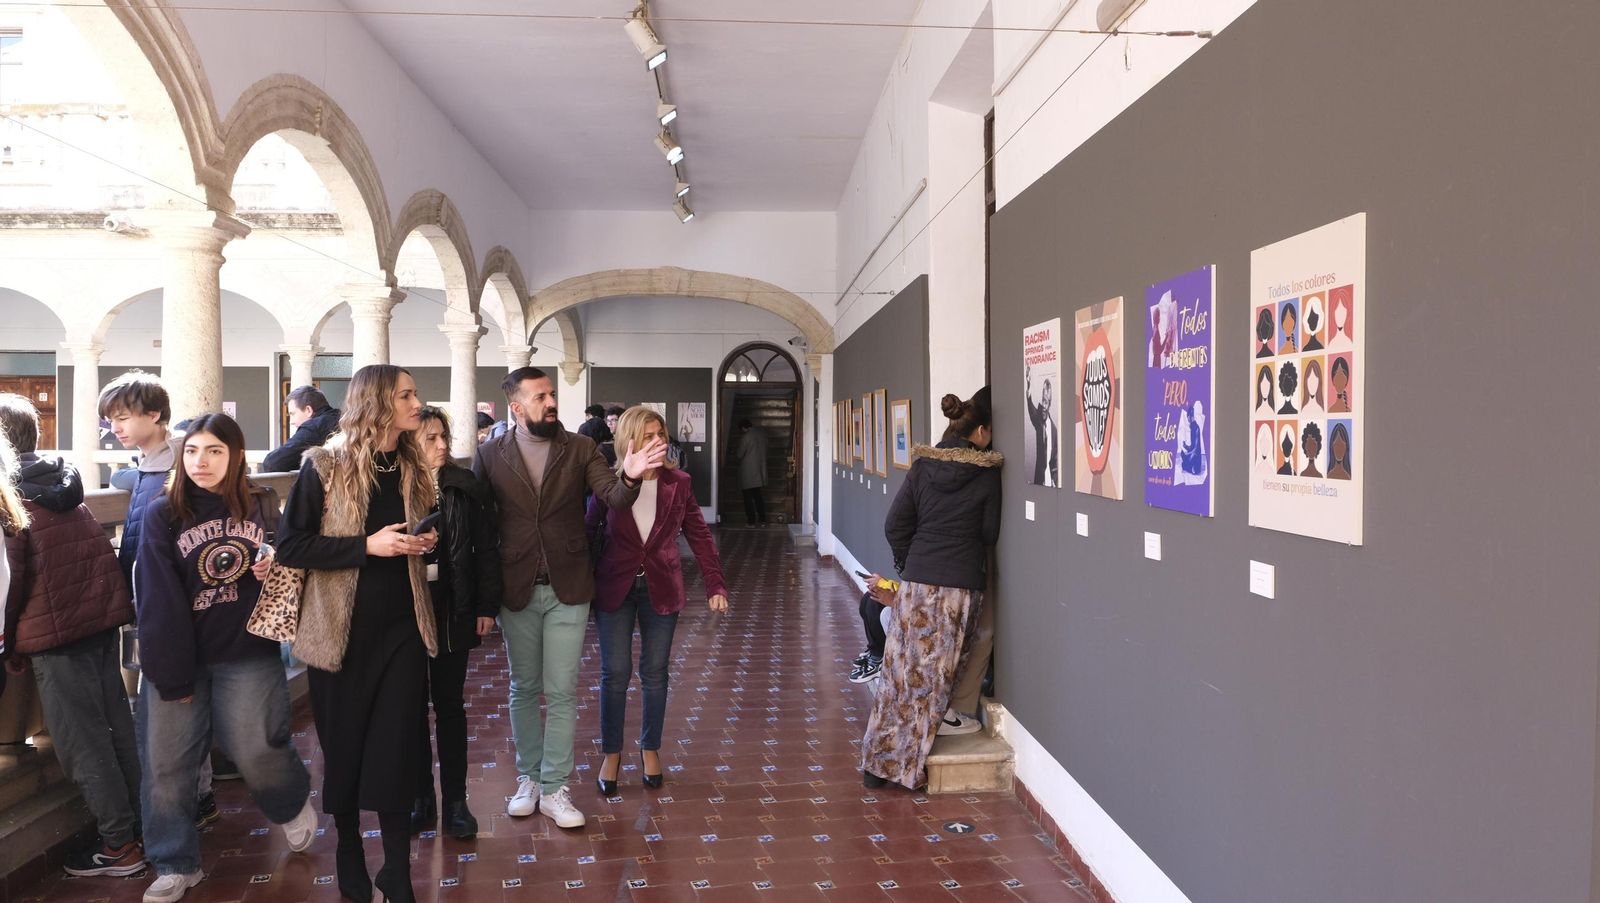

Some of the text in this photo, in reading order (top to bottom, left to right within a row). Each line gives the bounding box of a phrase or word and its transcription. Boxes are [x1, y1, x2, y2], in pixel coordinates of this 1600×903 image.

[1268, 272, 1336, 299] Todos los colores
[1025, 329, 1050, 346] RACISM
[1025, 345, 1044, 356] SPRINGS
[1025, 351, 1057, 367] IGNORANCE
[1085, 357, 1108, 382] TODOS
[1083, 379, 1110, 409] SOMOS
[1281, 482, 1290, 493] su
[1290, 483, 1313, 496] propia
[1313, 482, 1338, 497] belleza
[177, 517, 264, 558] MONTE CARLO
